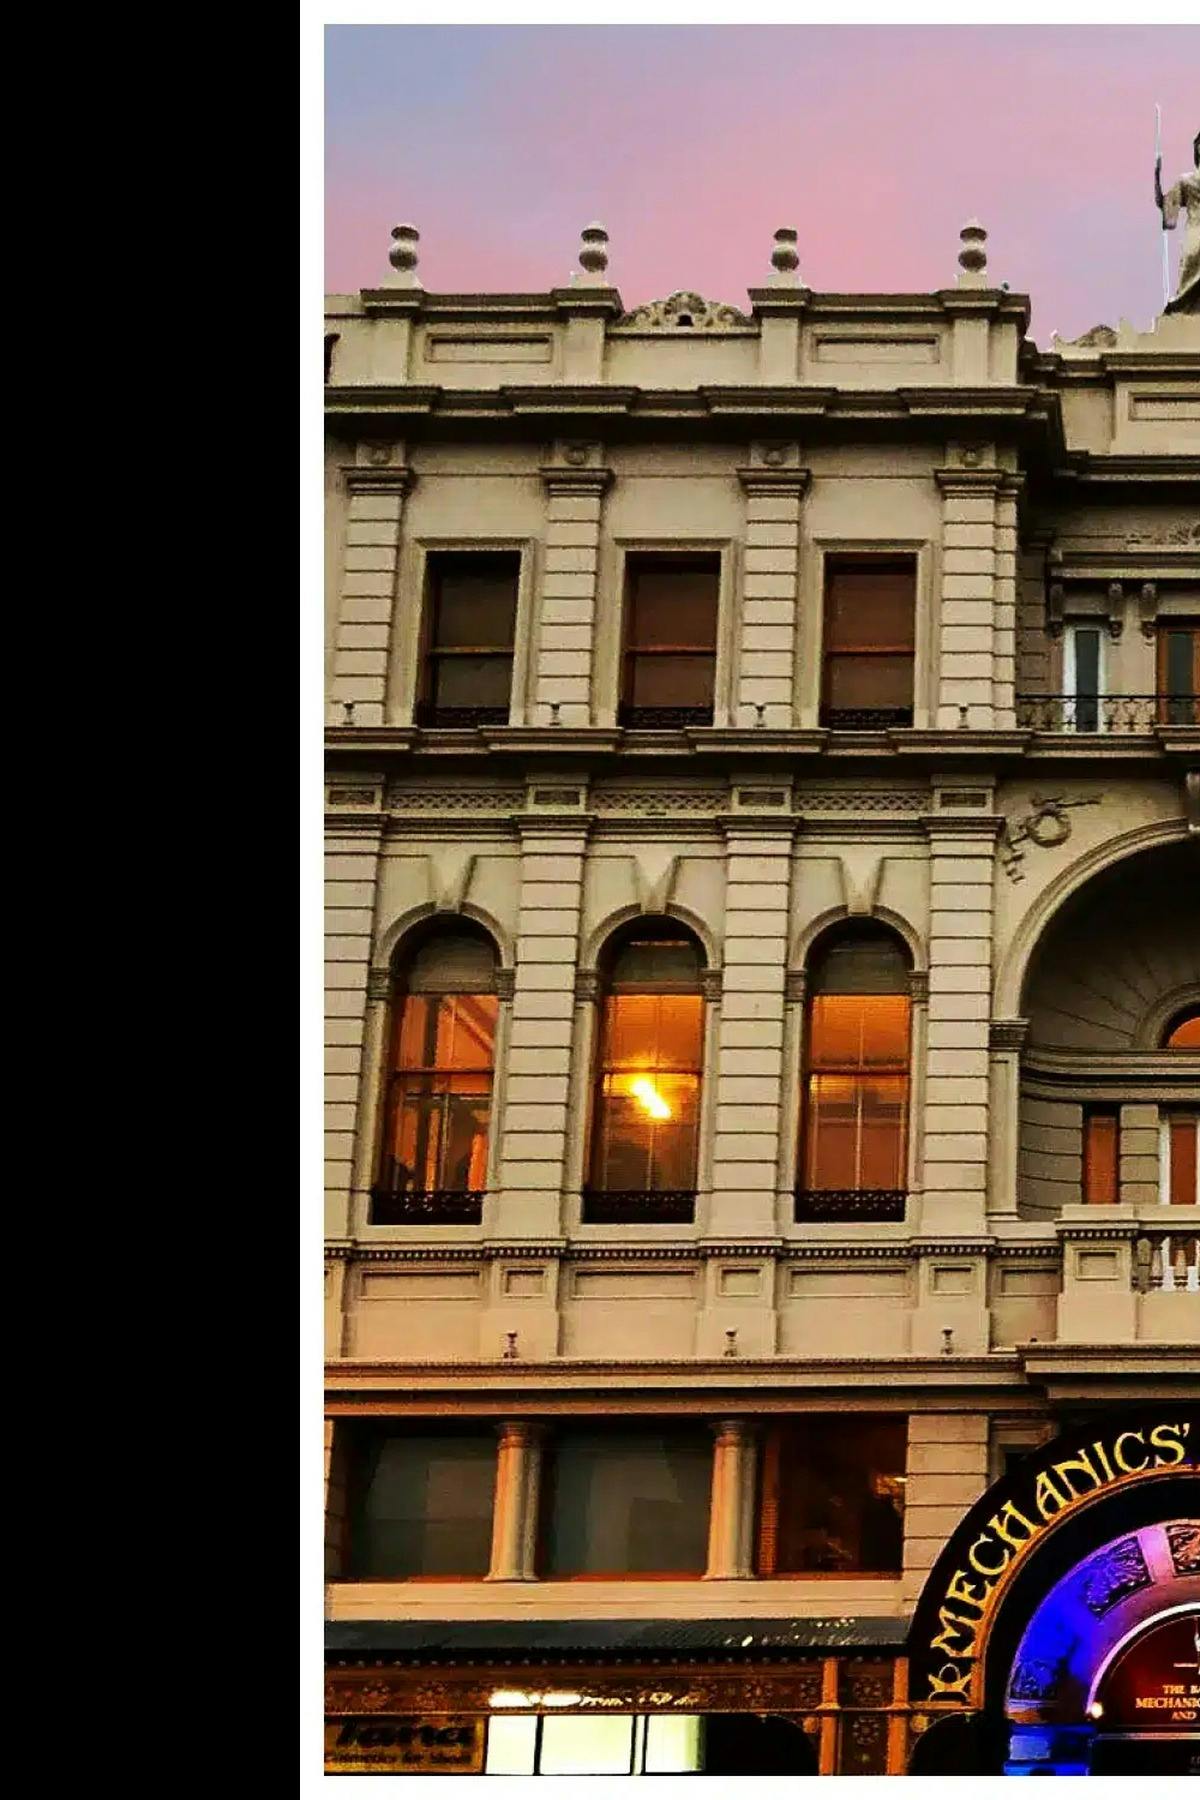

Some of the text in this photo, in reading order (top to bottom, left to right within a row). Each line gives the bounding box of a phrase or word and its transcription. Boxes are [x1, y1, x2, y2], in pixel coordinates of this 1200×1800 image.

[930, 1423, 1190, 1658] MECHANICS'
[1162, 1684, 1185, 1694] THE
[1172, 1711, 1197, 1720] AND
